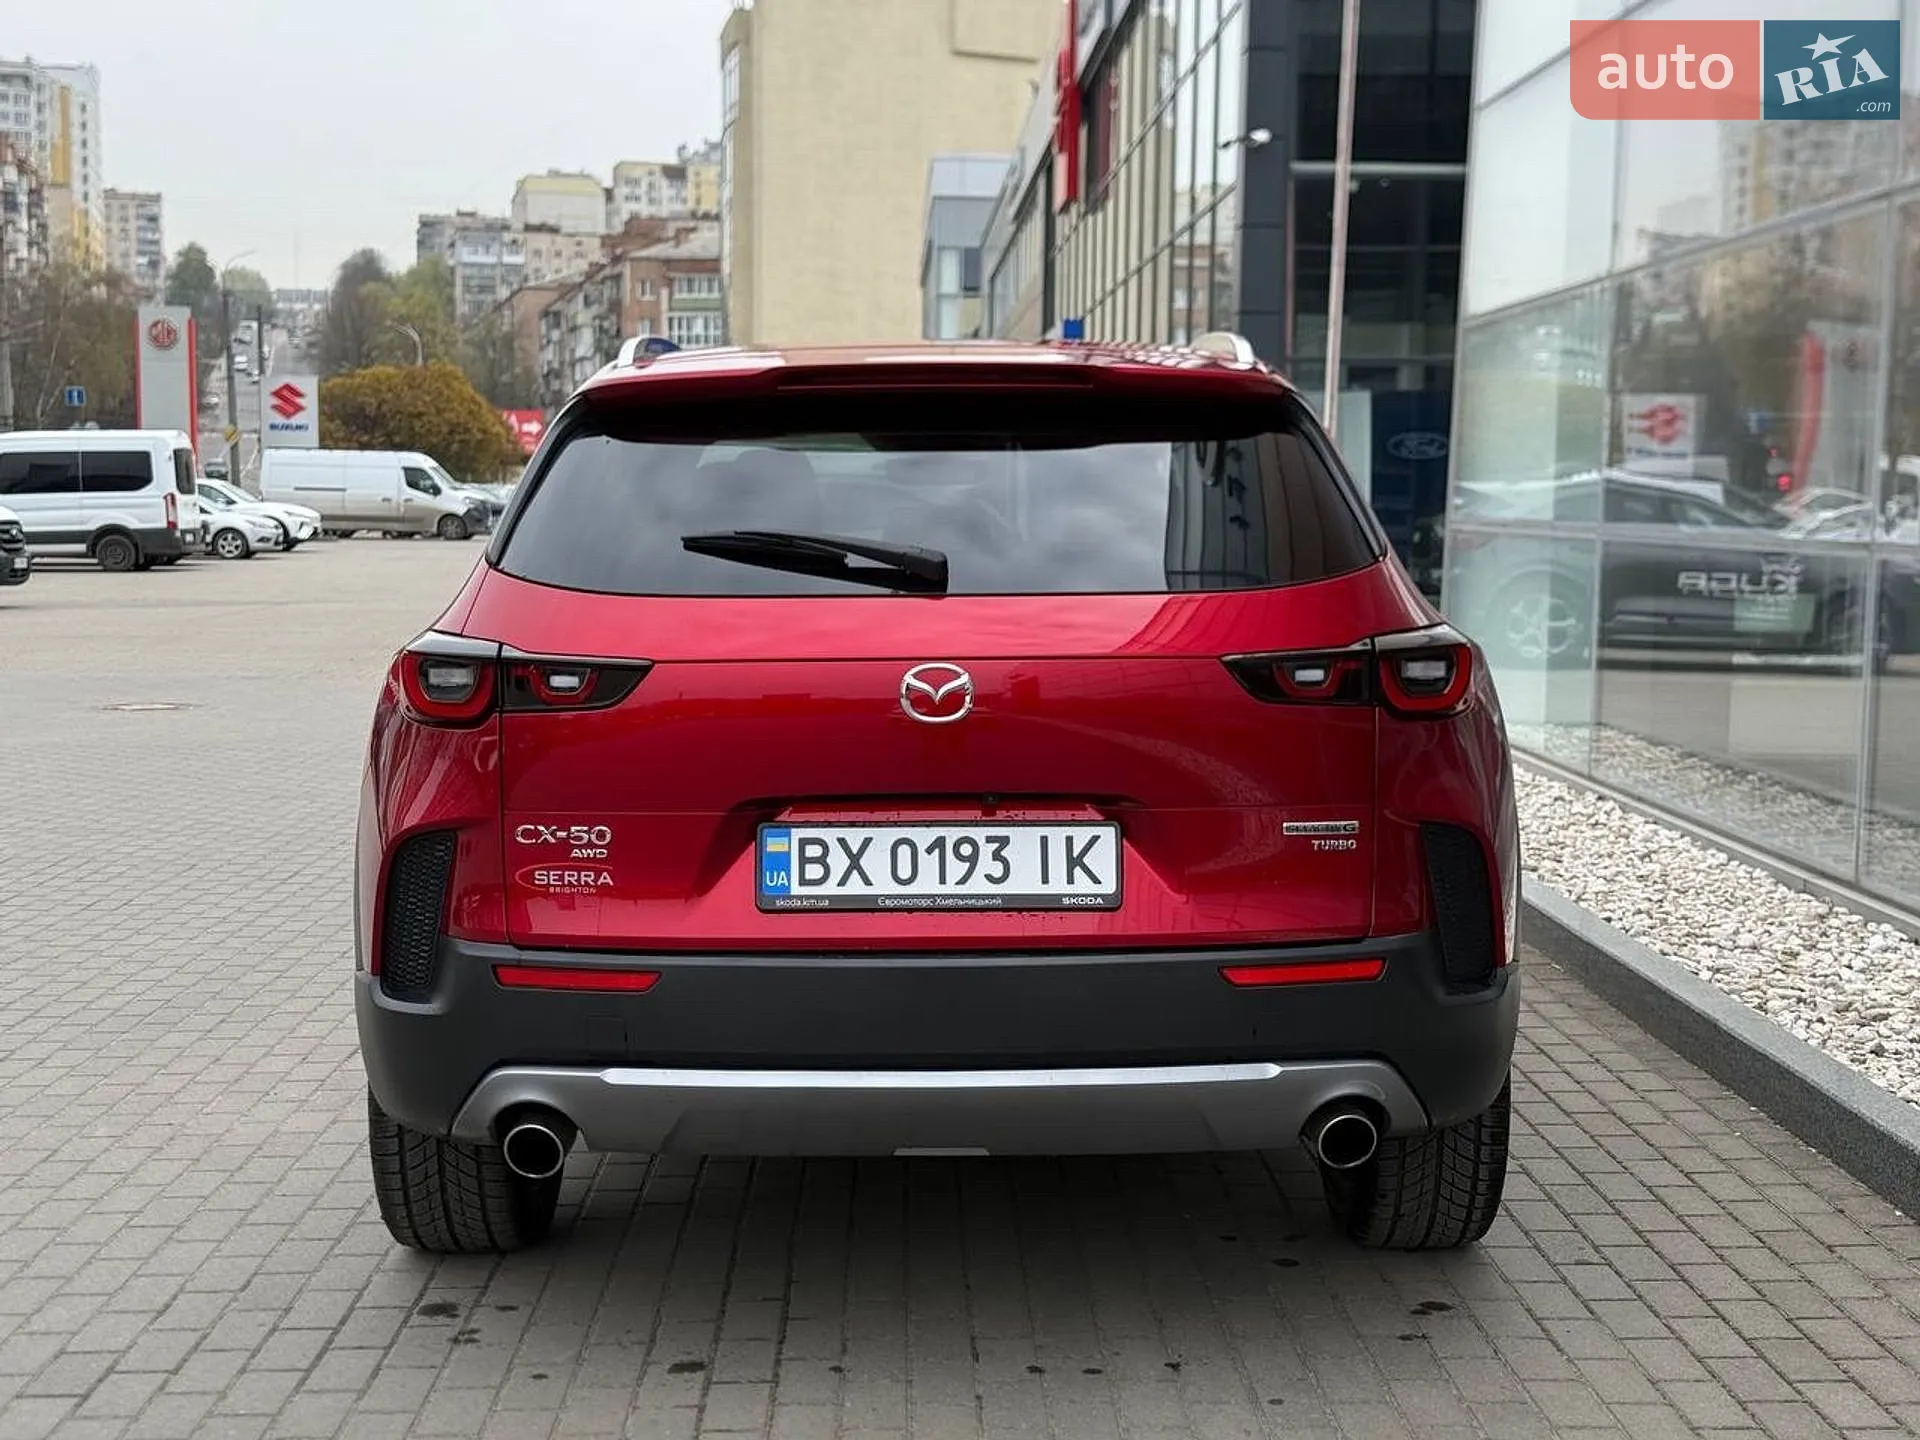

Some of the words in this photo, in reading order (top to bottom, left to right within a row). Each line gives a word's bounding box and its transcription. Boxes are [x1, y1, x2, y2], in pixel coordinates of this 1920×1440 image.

[515, 824, 612, 845] CX-50
[1311, 839, 1357, 851] TURBO
[570, 848, 608, 858] AWD
[798, 836, 874, 887] BX
[890, 835, 1011, 886] 0193
[1040, 834, 1102, 885] IK
[534, 870, 614, 886] SERRA
[766, 871, 788, 886] UA
[549, 886, 597, 894] BRIGHTON
